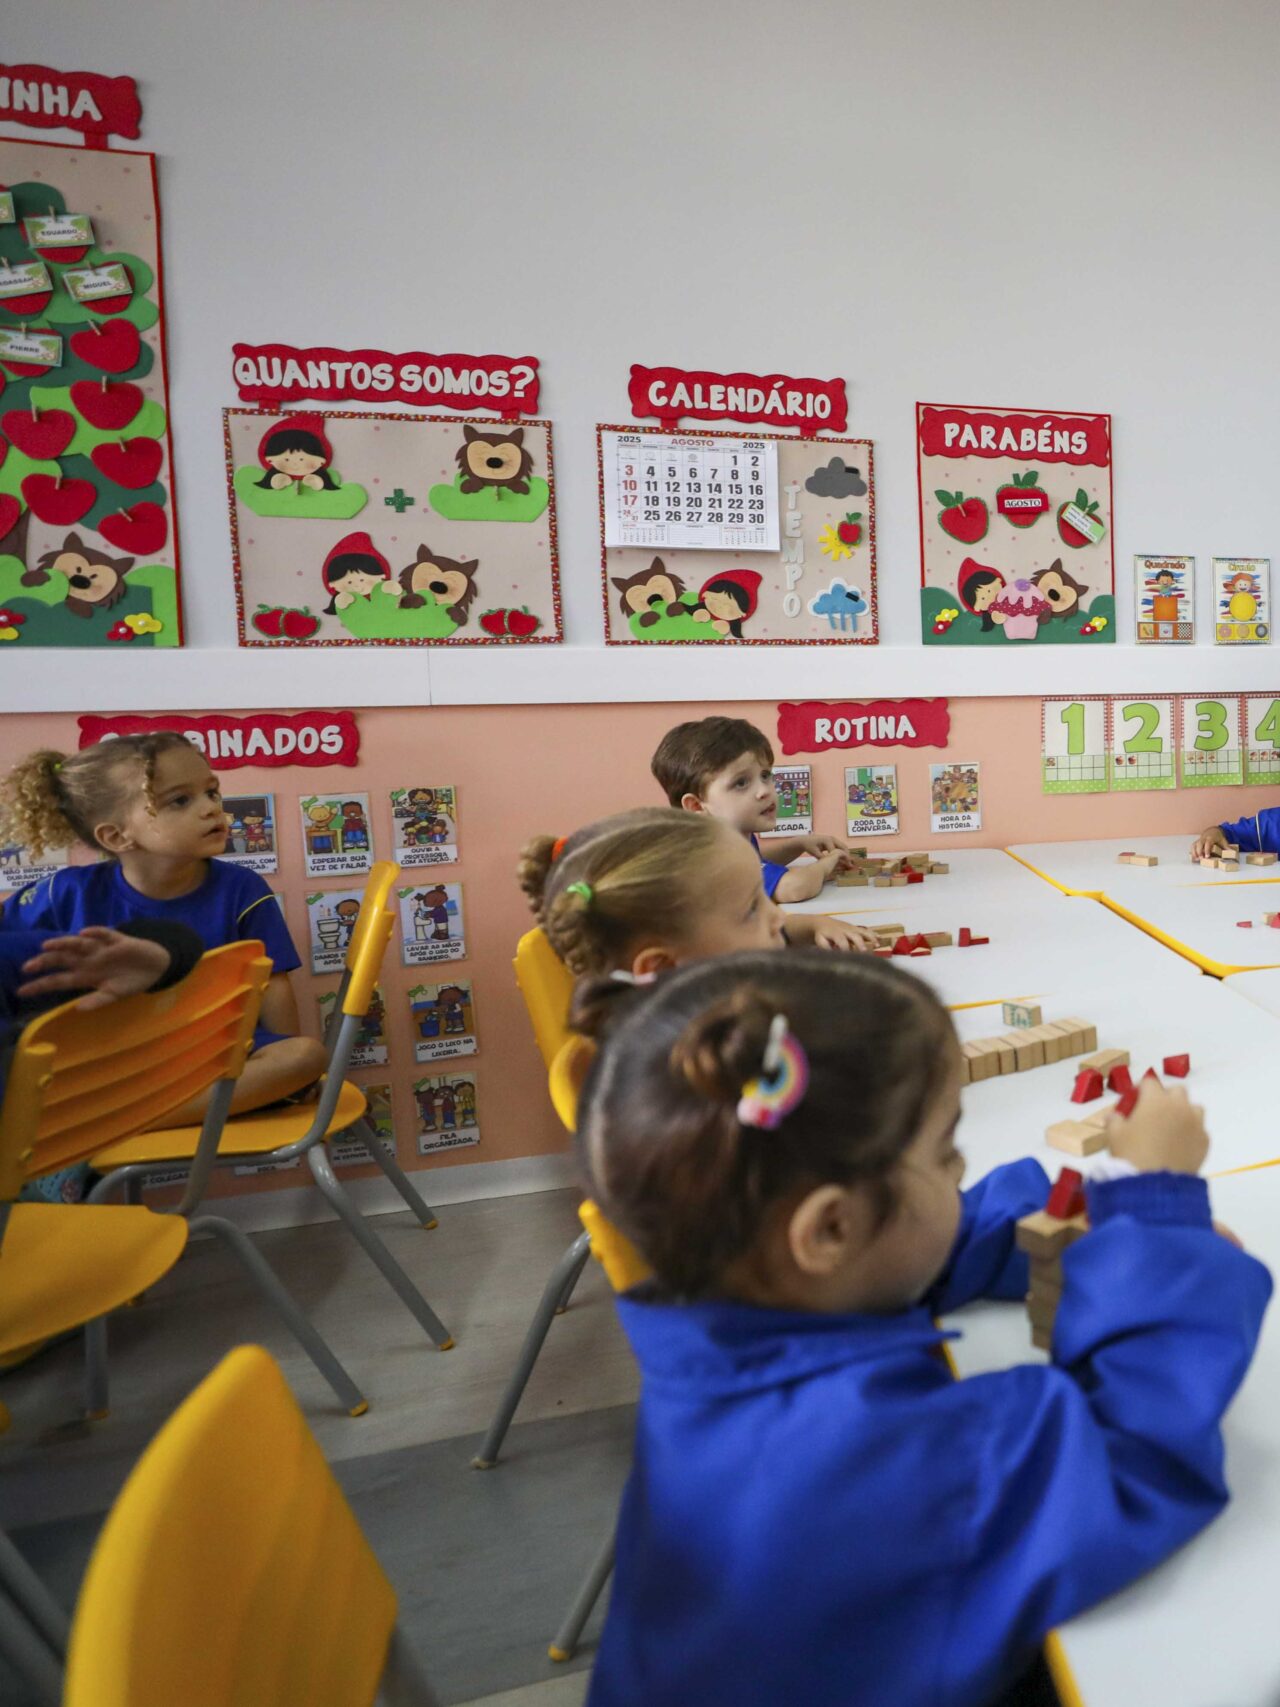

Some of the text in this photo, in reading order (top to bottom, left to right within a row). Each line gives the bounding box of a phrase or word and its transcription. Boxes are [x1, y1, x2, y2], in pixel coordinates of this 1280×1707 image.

[83, 280, 112, 290] MIGUEL
[234, 356, 536, 398] QUANTOS SOMOS?
[648, 380, 831, 419] CALENDÁRIO
[617, 435, 641, 444] 2025
[671, 438, 714, 447] AGOSTO
[742, 441, 766, 449] 2025
[943, 421, 1088, 455] PARABÉNS
[731, 455, 759, 466] 1 2
[625, 465, 759, 480] 3 4 5 6 7 8 9
[622, 480, 763, 495] 10 11 12 13 14 15 16
[623, 495, 764, 510] 17 18 19 20 21 22 23
[1005, 499, 1041, 507] AGOSTO
[644, 510, 764, 524] 25 26 27 28 29 30
[782, 485, 805, 618] TEMPO
[1144, 560, 1186, 570] Quadrado
[814, 715, 917, 744] ROTINA
[1060, 703, 1085, 755] 1
[1122, 702, 1163, 753] 2
[1193, 700, 1229, 751] 3
[851, 825, 895, 833] CONVERSA.
[3, 867, 20, 875] NÃO
[441, 941, 461, 949] MÃOS
[314, 953, 339, 961] DAMOS
[417, 1043, 437, 1051] JOGO
[445, 1040, 461, 1048] LIXO
[439, 1132, 457, 1140] FILA
